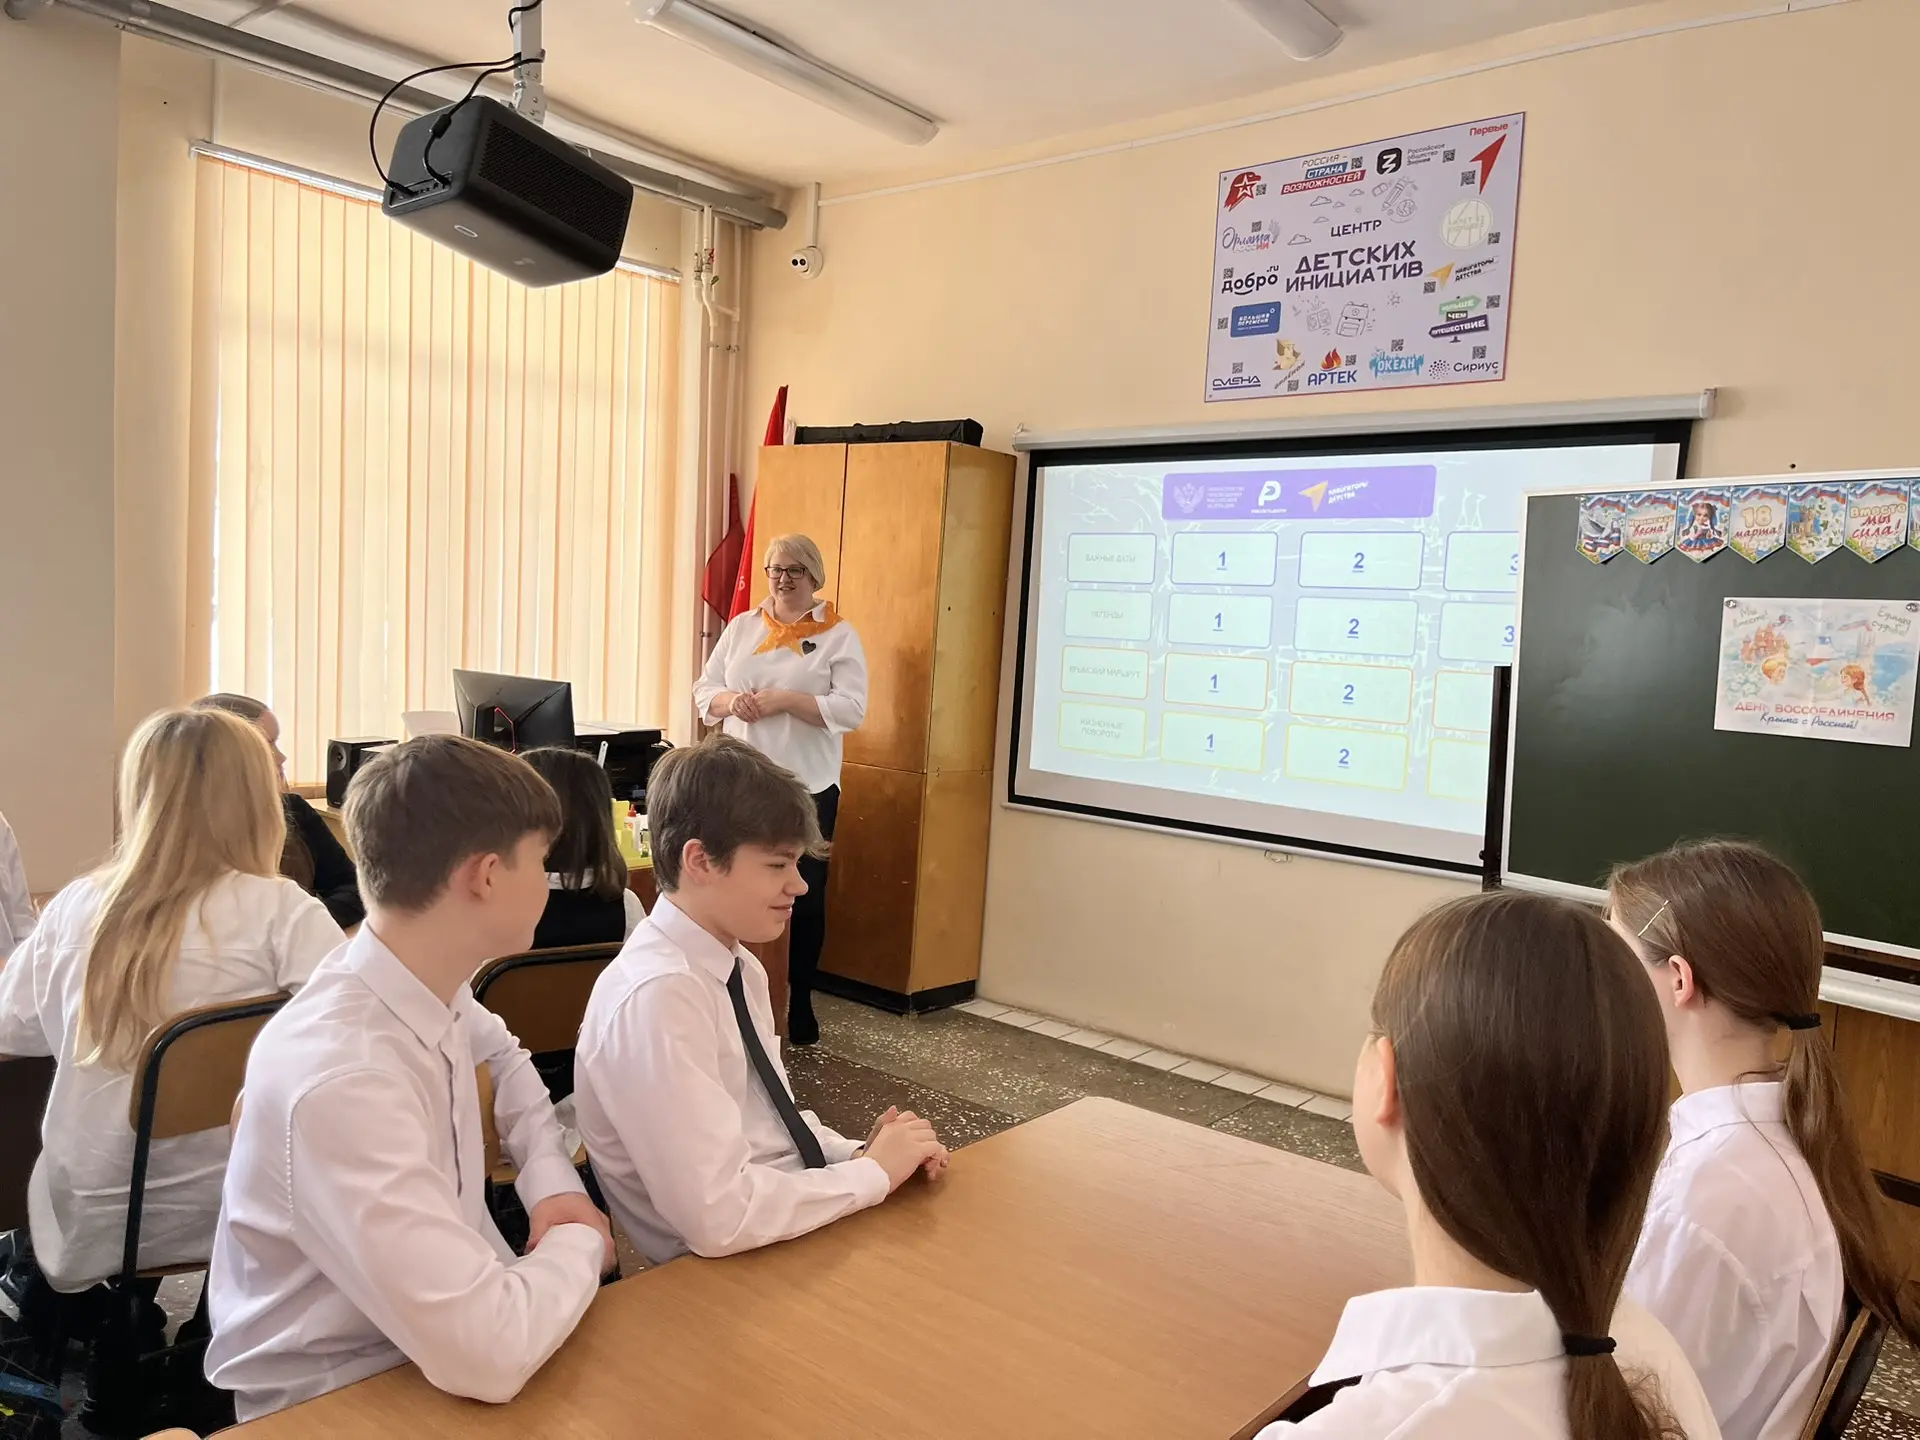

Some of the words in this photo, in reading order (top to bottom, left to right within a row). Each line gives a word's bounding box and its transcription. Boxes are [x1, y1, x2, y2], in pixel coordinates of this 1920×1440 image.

[1470, 123, 1508, 136] Первые
[1302, 154, 1340, 168] РОССИЯ
[1307, 165, 1344, 179] СТРАНА
[1283, 171, 1362, 194] ВОЗМОЖНОСТЕЙ
[1330, 220, 1382, 238] ЦЕНТР
[1295, 240, 1417, 275] ДЕТСКИХ
[1455, 258, 1495, 274] НАВИГАТОРЫ
[1221, 272, 1279, 294] добро
[1285, 261, 1424, 293] ИНИЦИАТИВ
[1454, 268, 1482, 283] ДЕТСТВА
[1377, 358, 1415, 371] ОКЕАН
[1453, 361, 1499, 373] Сириус
[1307, 370, 1357, 386] АРТЕК
[1741, 505, 1772, 528] 18
[1734, 524, 1783, 540] марта!
[1852, 519, 1901, 539] сила!
[1218, 551, 1227, 568] 1
[1353, 551, 1366, 571] 2
[1214, 612, 1223, 629] 1
[1348, 617, 1361, 637] 2
[1503, 625, 1515, 643] 3
[1209, 673, 1219, 690] 1
[1342, 683, 1355, 703] 2
[1775, 703, 1895, 721] ВОССОЕДИНЕНИЯ
[1205, 733, 1215, 750] 1
[1338, 748, 1351, 767] 2
